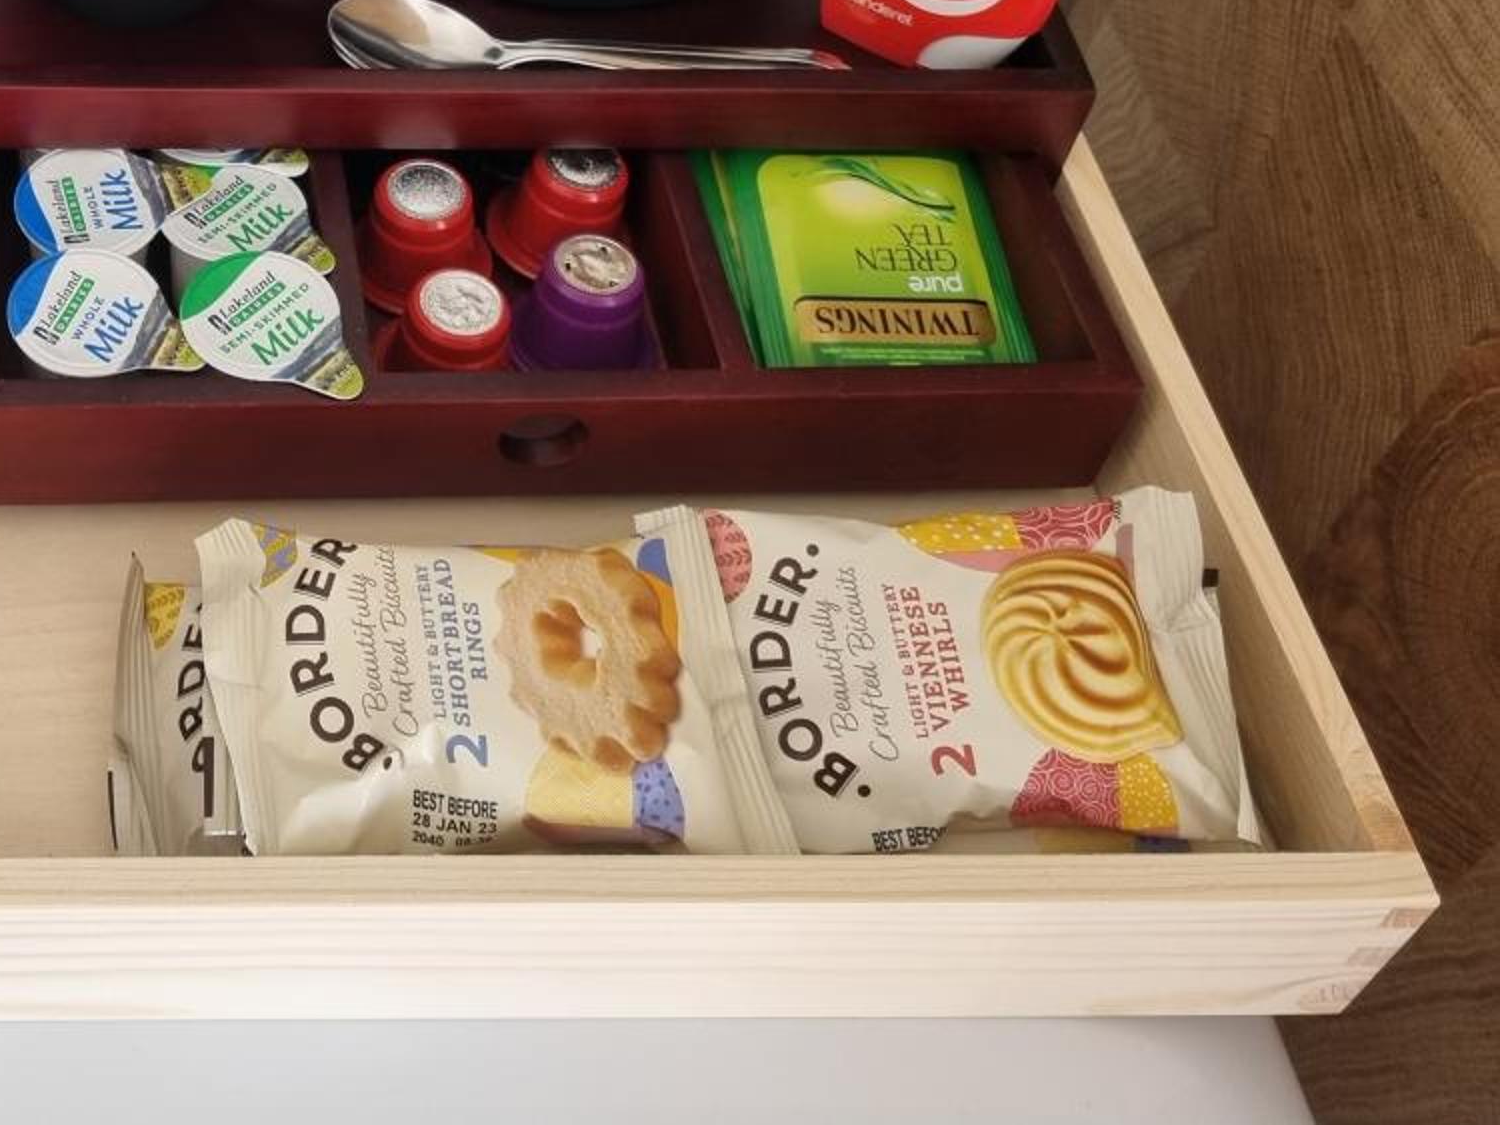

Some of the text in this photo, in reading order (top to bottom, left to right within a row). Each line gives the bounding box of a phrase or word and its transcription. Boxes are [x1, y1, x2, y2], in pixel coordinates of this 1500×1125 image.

[47, 179, 74, 234] Lakeland
[83, 185, 104, 230] WHOLE
[100, 168, 144, 230] Milk
[195, 174, 245, 215] Lakeland
[197, 182, 278, 244] SEMI-SKIMMED
[226, 203, 293, 251] Milk
[891, 223, 953, 248] TEA
[853, 247, 958, 273] GREEN
[907, 275, 965, 293] pure
[45, 270, 83, 327] Lakeland
[70, 295, 106, 341] WHOLE
[218, 270, 277, 319] Lakeland
[218, 282, 310, 354] SEMI-SKIMMED
[815, 307, 981, 336] TWININGS
[84, 295, 144, 364] Milk
[251, 308, 325, 366] Milk
[415, 563, 439, 640] BUTTERY
[880, 583, 912, 659] BUTTERY
[348, 571, 386, 722] Beautifully
[434, 558, 472, 728] SHORTBREAD
[462, 602, 489, 682] RINGS
[810, 598, 860, 741] Beautifully
[837, 566, 900, 762] Crafted Biscuits
[900, 586, 949, 732] VIENNESE
[927, 600, 972, 712] WHIRLS
[388, 634, 420, 738] Crafted
[430, 664, 448, 720] LIGHT
[904, 683, 930, 739] LIGHT
[445, 733, 489, 768] 2
[931, 744, 977, 777] 2
[412, 788, 498, 821] BEST BEFORE
[412, 811, 497, 835] 28 JAN 23
[871, 828, 903, 852] BEST
